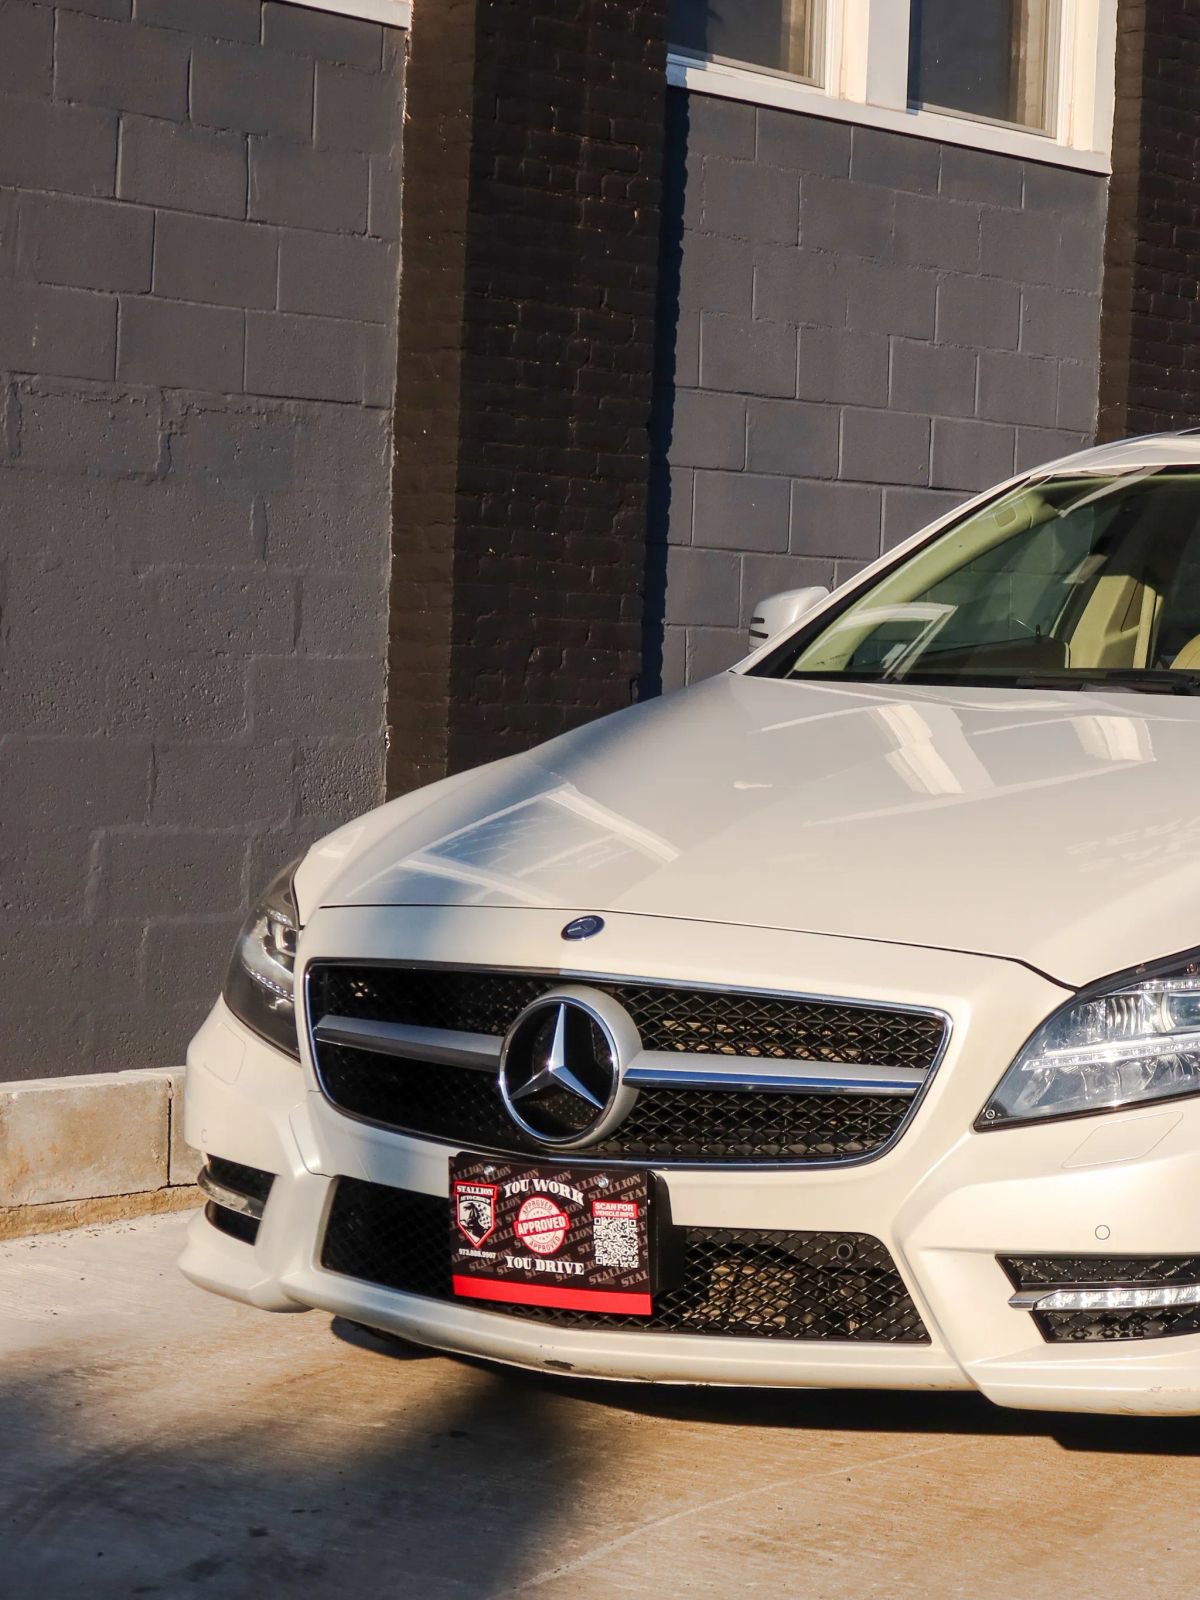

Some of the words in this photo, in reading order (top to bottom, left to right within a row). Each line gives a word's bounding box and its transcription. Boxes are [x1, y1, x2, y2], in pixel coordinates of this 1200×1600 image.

[457, 1185, 494, 1196] STALLION
[504, 1178, 530, 1198] YOU
[532, 1178, 584, 1207] WORK
[523, 1200, 553, 1214] APPROVED
[595, 1203, 617, 1211] SCAN
[618, 1204, 633, 1212] FOR
[517, 1216, 566, 1235] APPROVED
[529, 1236, 560, 1251] APPROVED
[505, 1256, 532, 1270] YOU
[534, 1259, 584, 1275] DRIVE
